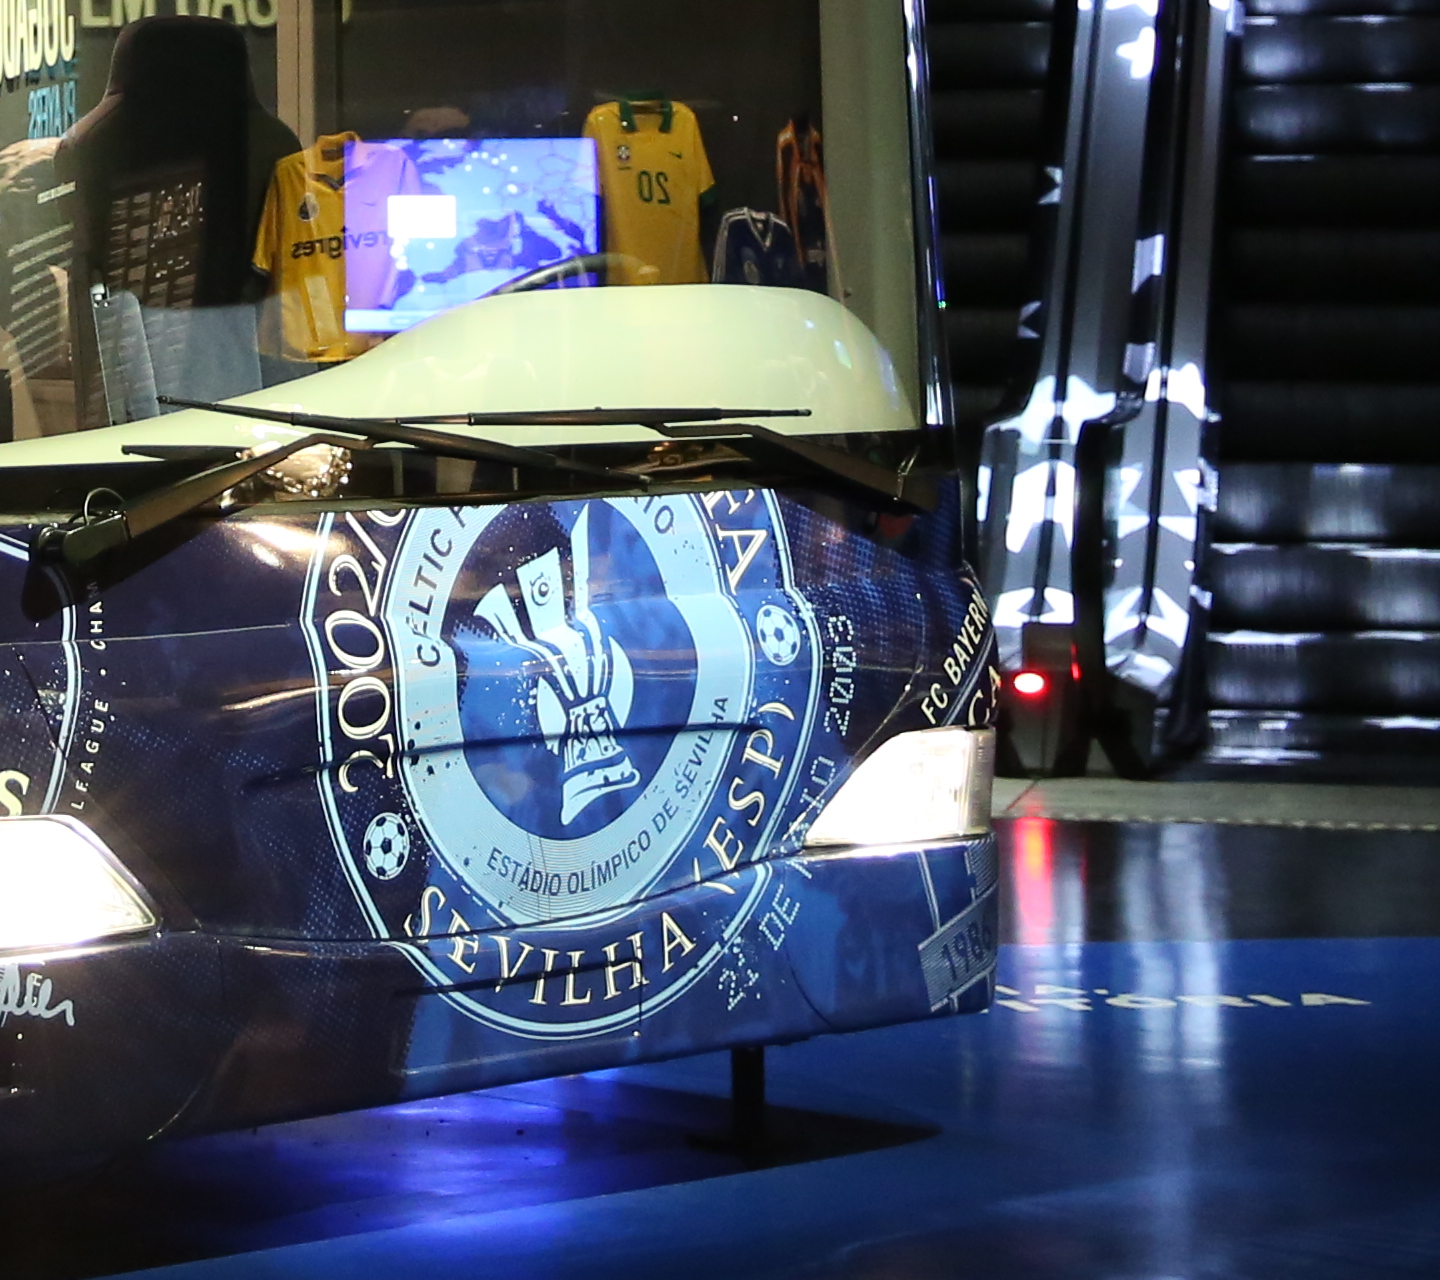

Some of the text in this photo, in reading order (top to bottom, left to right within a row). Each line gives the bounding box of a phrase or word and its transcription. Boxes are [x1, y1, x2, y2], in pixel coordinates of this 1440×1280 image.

[920, 590, 989, 727] FC BAYERN
[403, 700, 796, 1008] SEVILHA (ESP)
[486, 695, 729, 898] ESTÁDIO OLÍMPICO DE SEVILHA
[760, 884, 801, 951] DE
